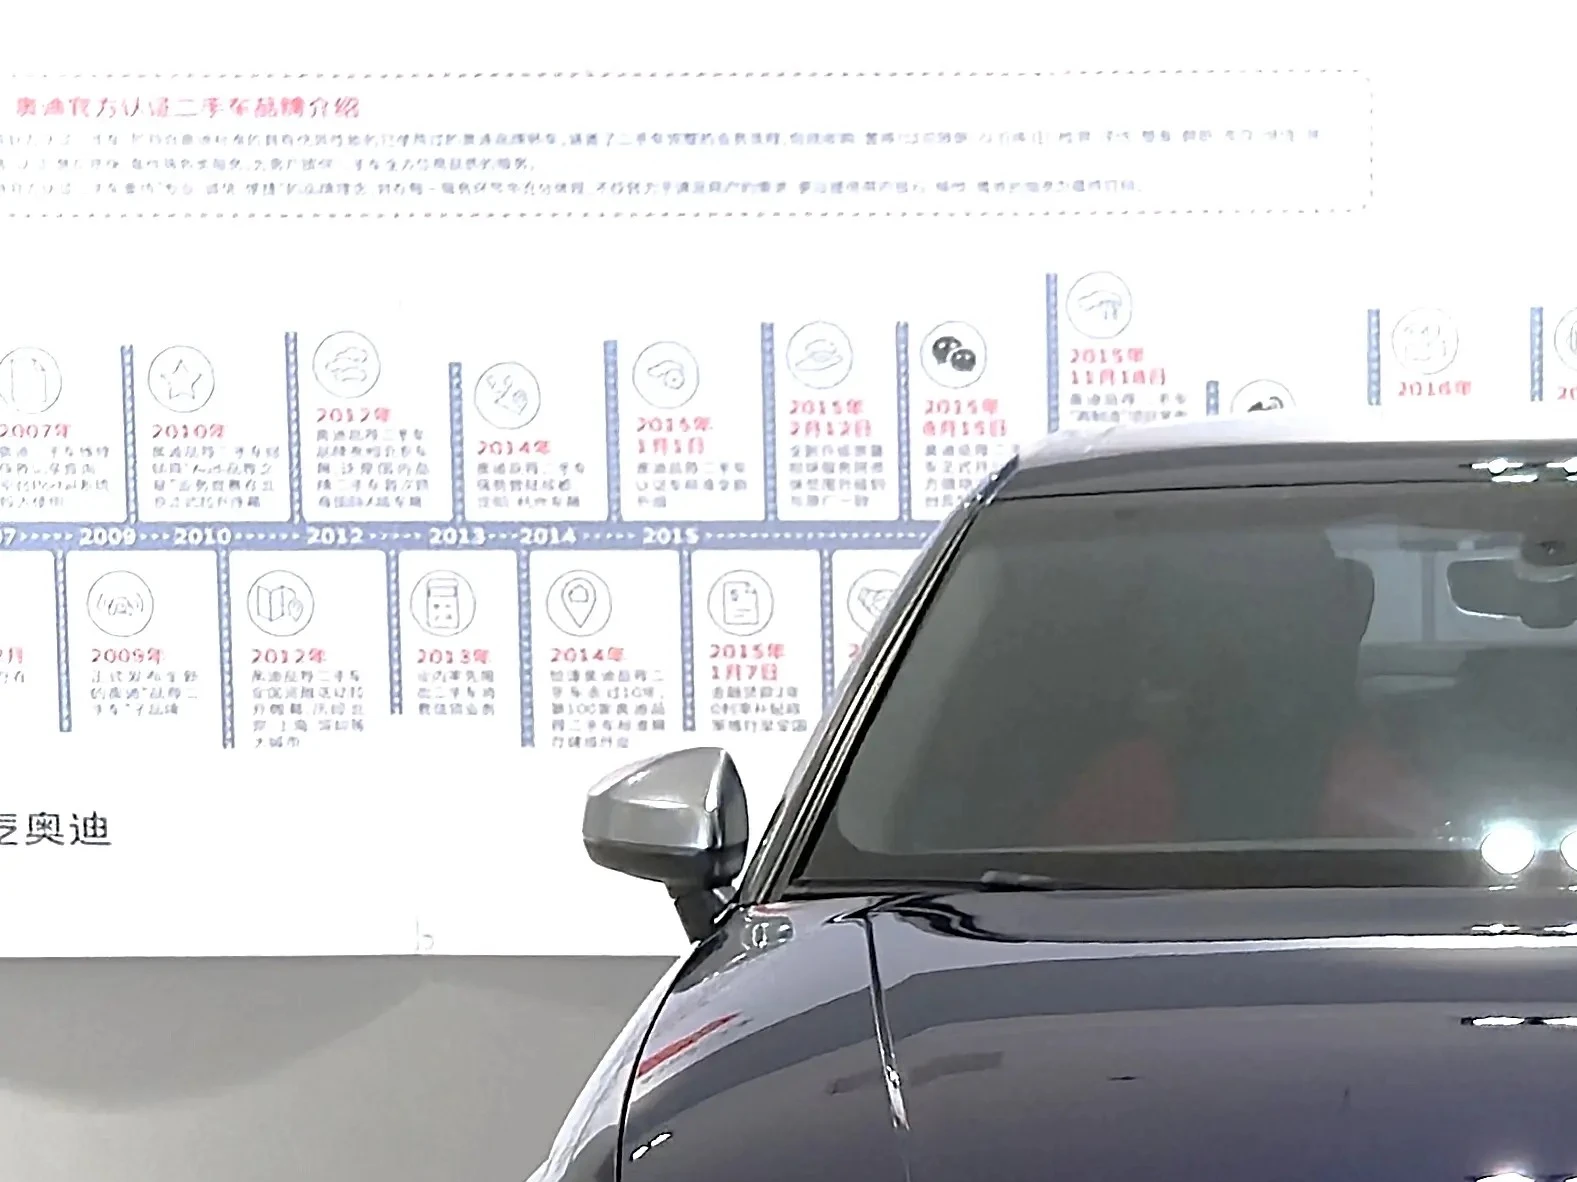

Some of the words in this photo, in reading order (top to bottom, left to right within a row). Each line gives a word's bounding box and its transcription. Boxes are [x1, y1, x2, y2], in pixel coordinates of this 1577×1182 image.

[1071, 348, 1143, 363] 2015年
[1399, 381, 1471, 396] 2016年
[790, 399, 862, 415] 2015年
[925, 399, 997, 415] 2015年
[80, 528, 135, 545] 2009
[175, 528, 231, 544] 2010
[308, 528, 362, 544] 2012
[430, 528, 485, 544] 2013
[521, 528, 576, 544] 2014
[644, 528, 698, 544] 2015
[710, 643, 784, 659] 2015年
